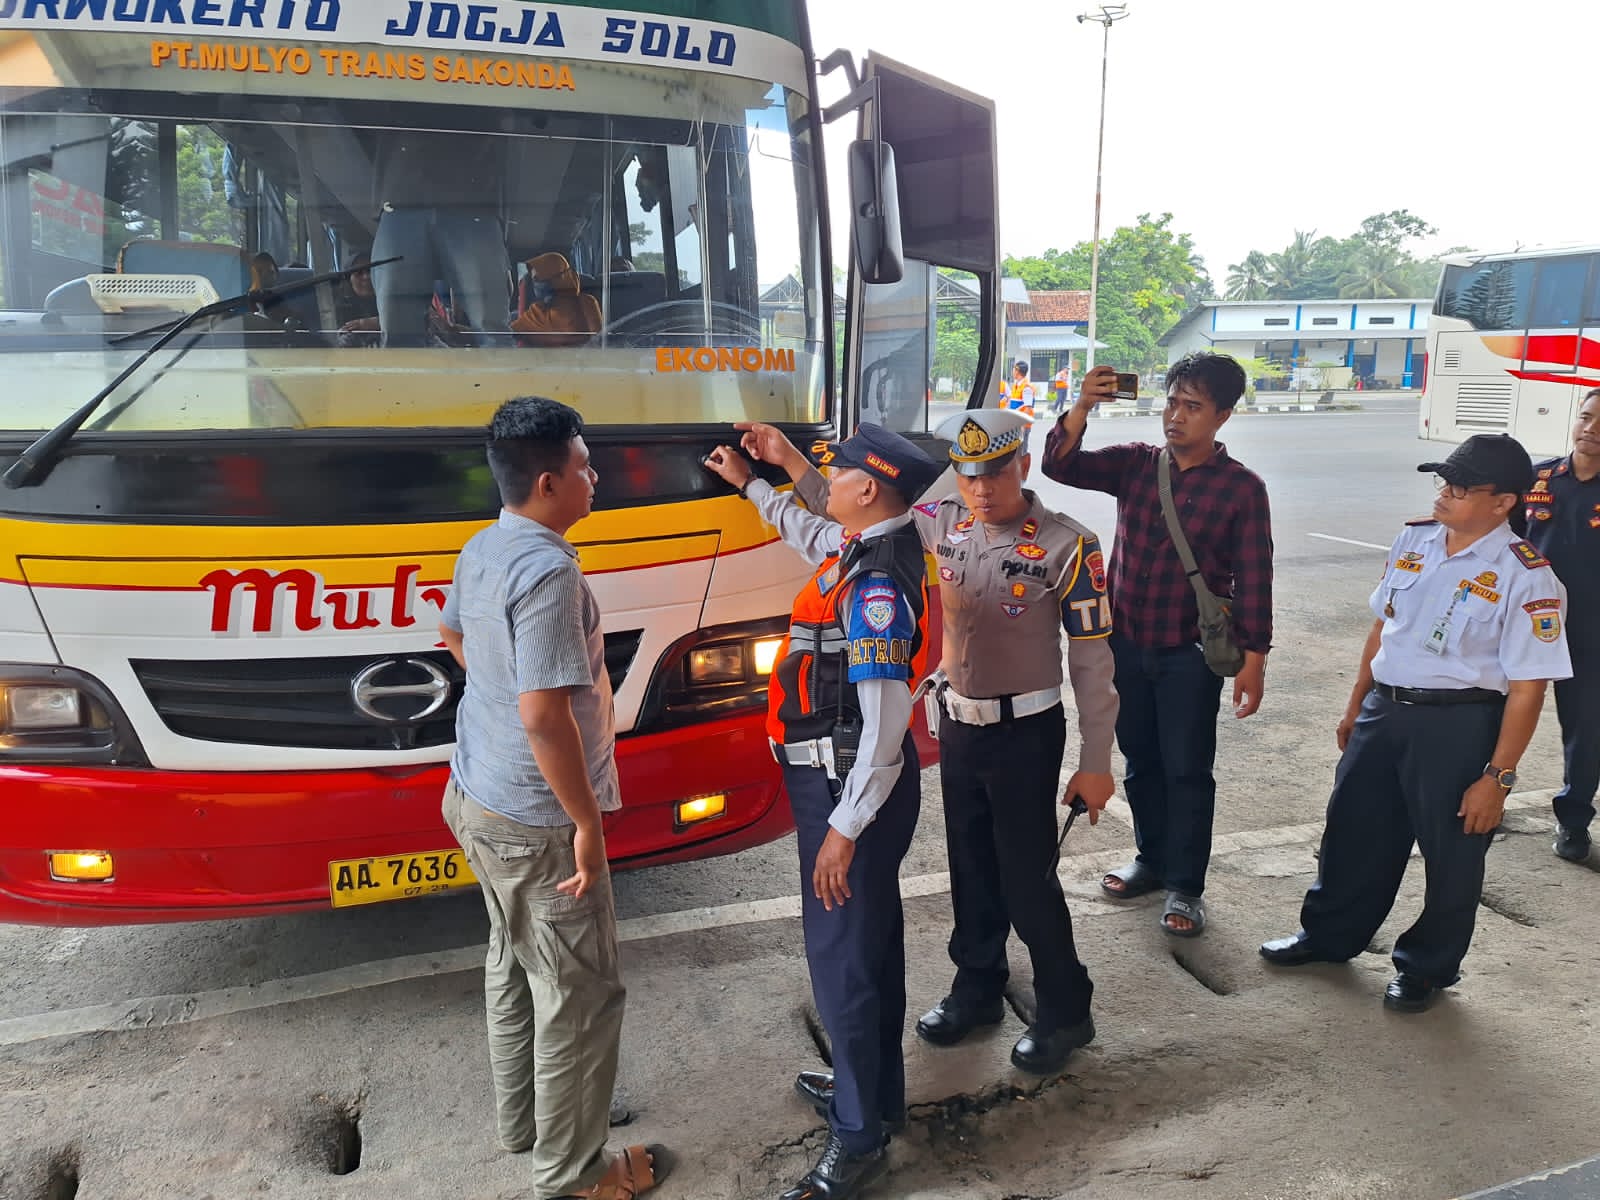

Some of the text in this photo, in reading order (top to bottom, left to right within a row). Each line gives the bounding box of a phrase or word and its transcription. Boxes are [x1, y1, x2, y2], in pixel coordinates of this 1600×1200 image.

[385, 1, 565, 48] JOGJA
[602, 17, 736, 67] SOLO
[152, 41, 576, 91] PT.MULYO TRANS SAKONDA
[655, 347, 796, 373] EKONOMI
[1001, 560, 1048, 579] POLRI
[388, 853, 459, 886] 7636
